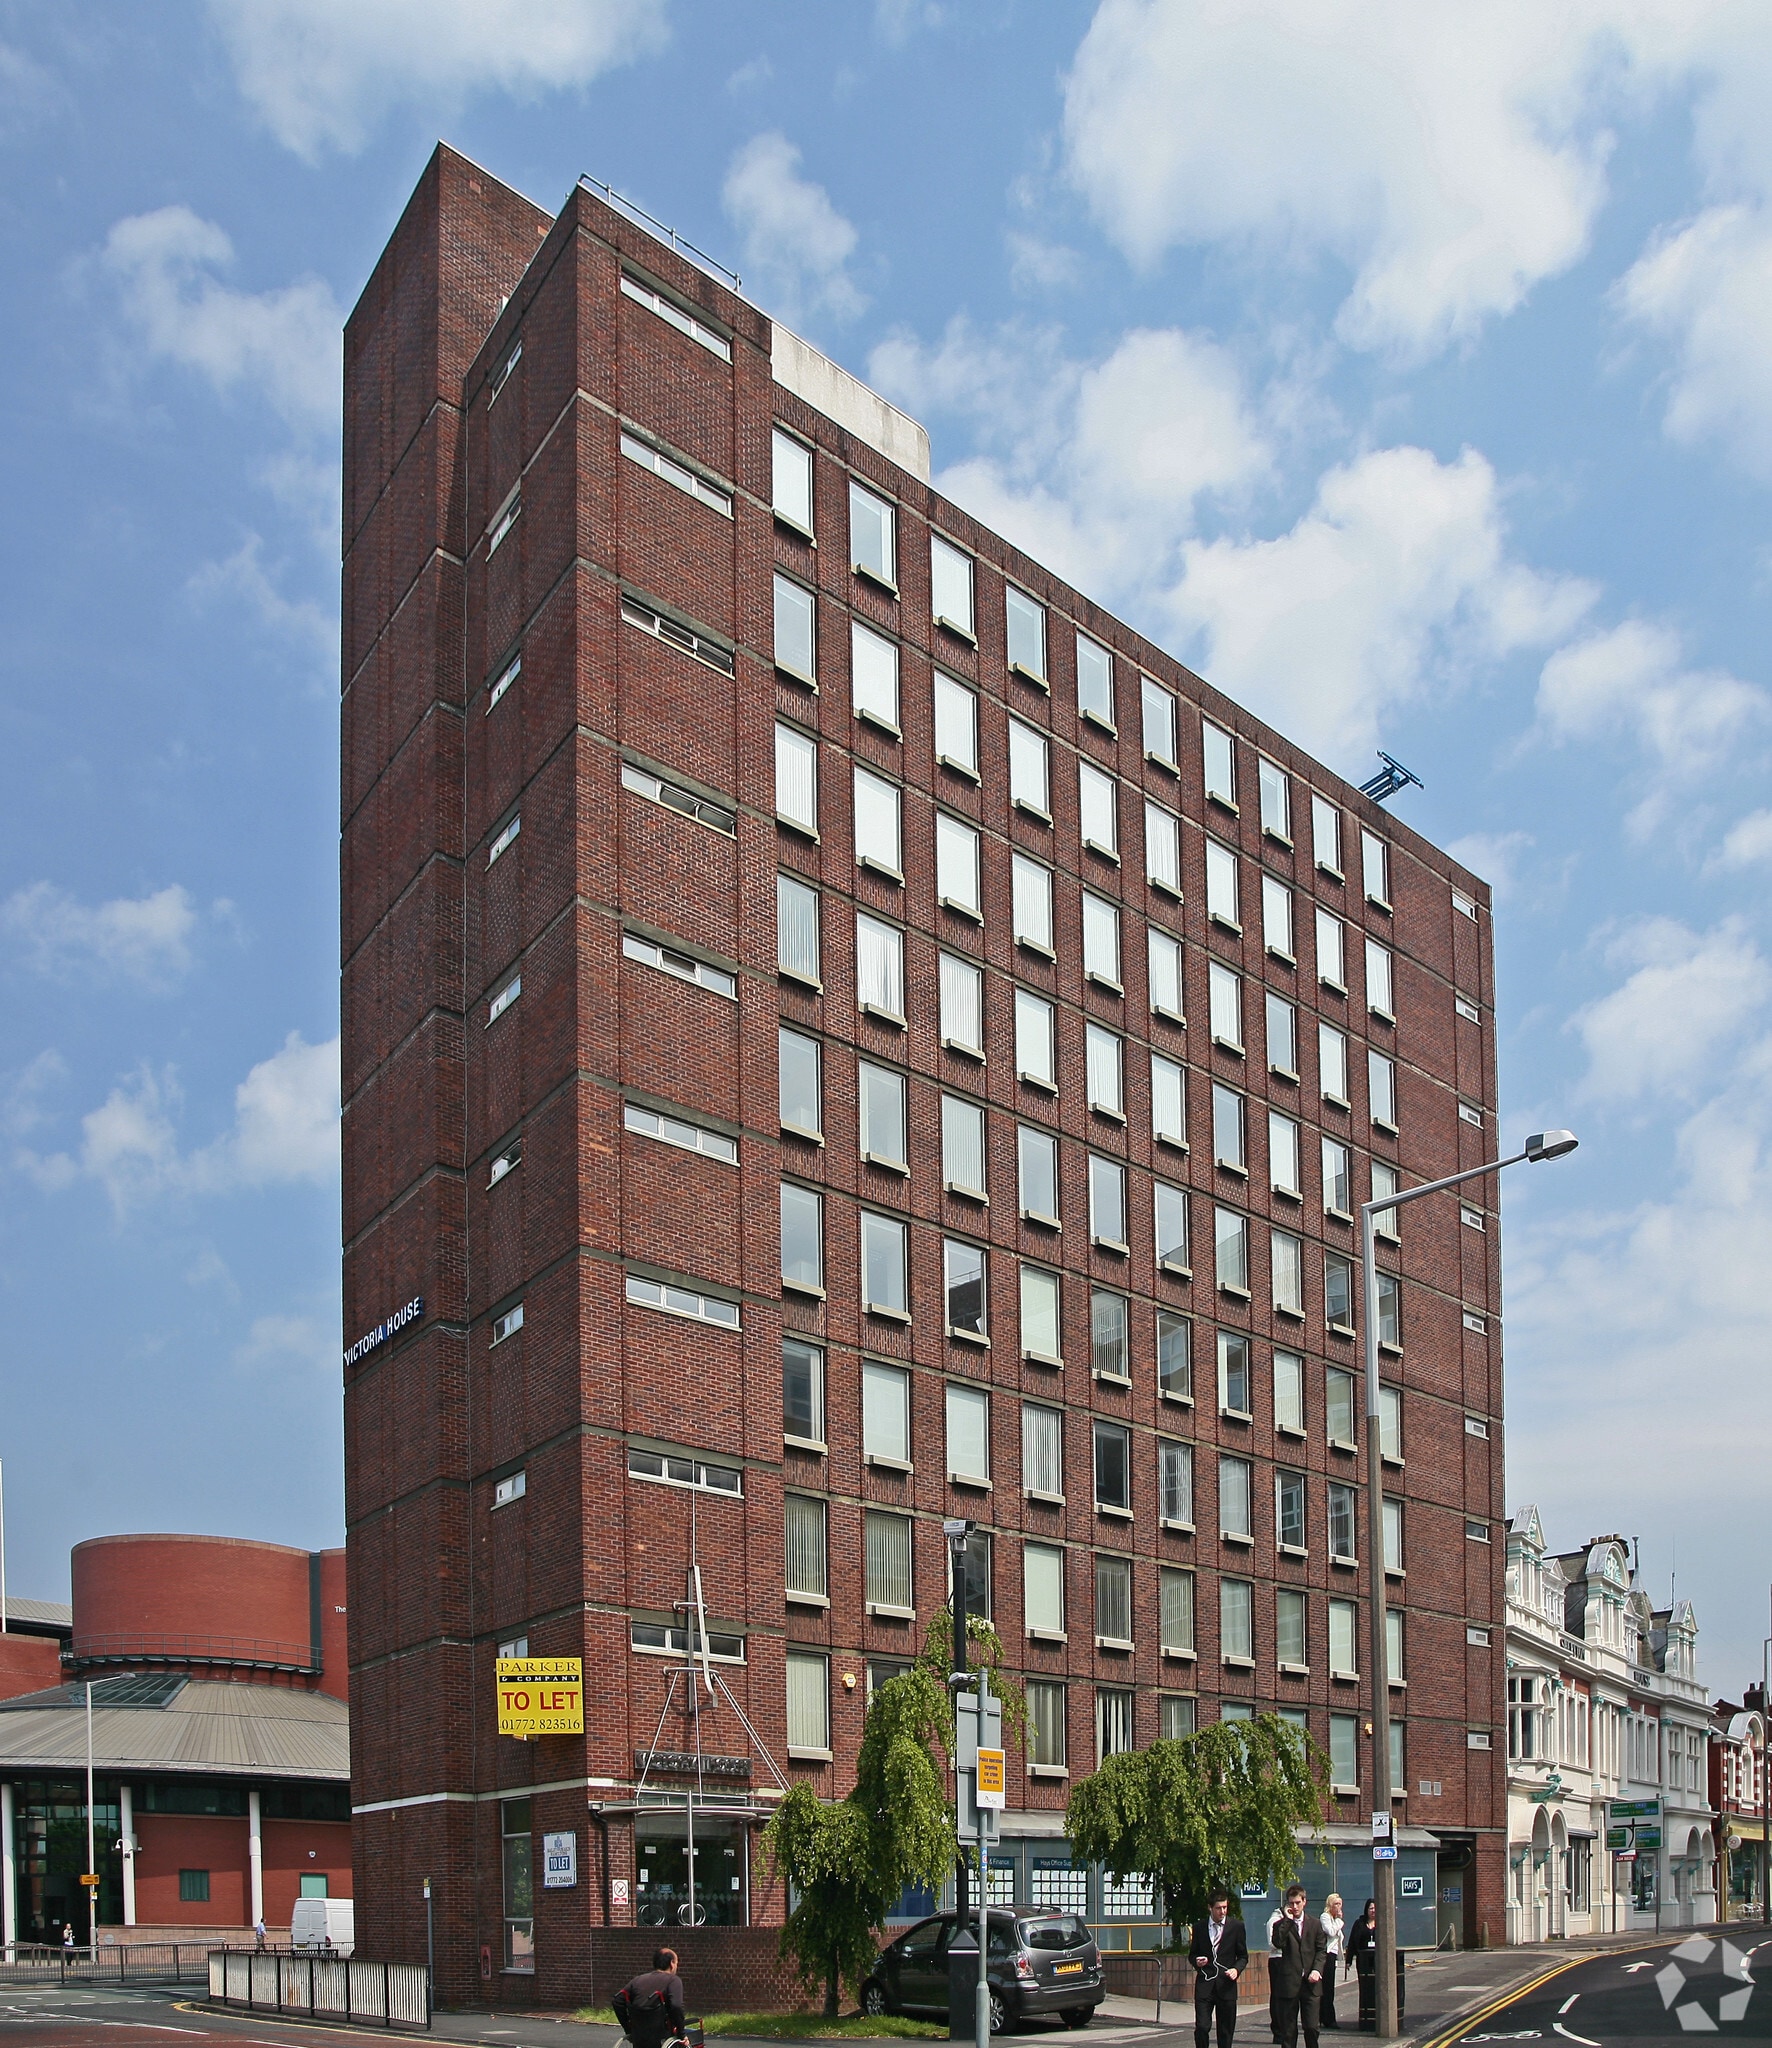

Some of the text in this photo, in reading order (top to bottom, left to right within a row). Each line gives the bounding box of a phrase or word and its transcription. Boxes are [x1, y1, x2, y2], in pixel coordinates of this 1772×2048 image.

[343, 1296, 420, 1367] VICTORIA HOUSE
[500, 1662, 579, 1672] PARKER
[502, 1691, 579, 1711] TO LET
[502, 1719, 580, 1729] 01772 823516
[550, 1857, 569, 1870] TO LET
[1243, 1882, 1260, 1891] HAYS
[1404, 1881, 1418, 1890] HAYS
